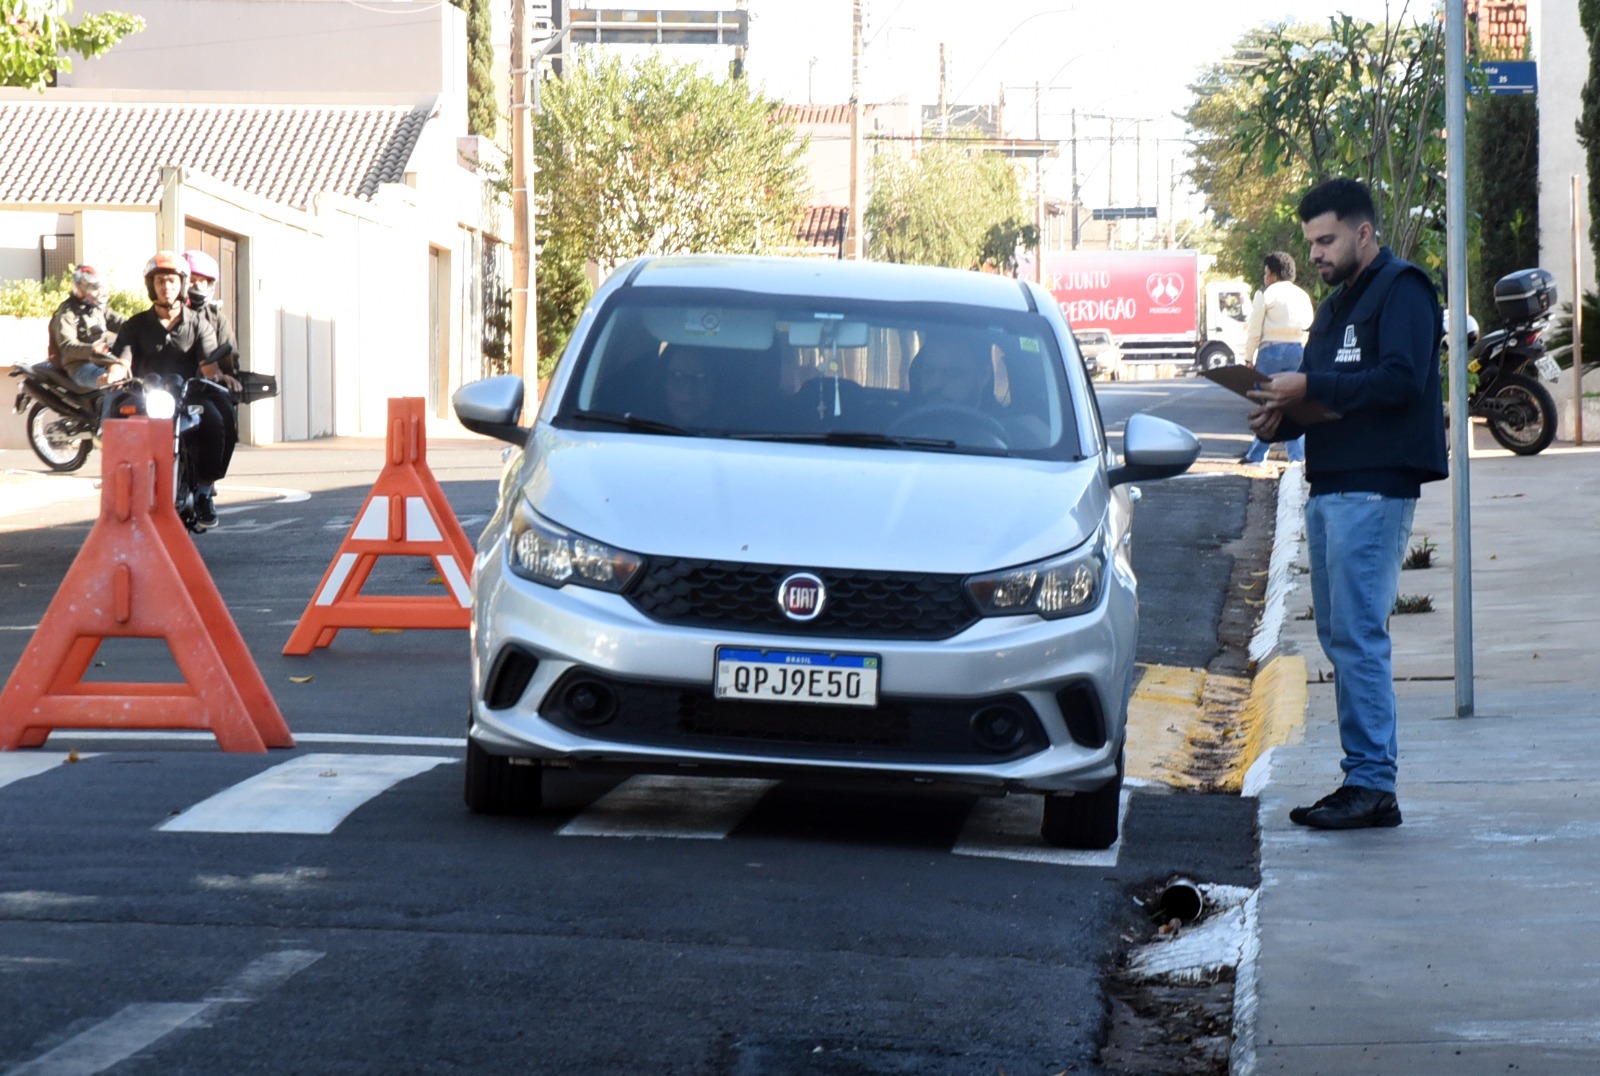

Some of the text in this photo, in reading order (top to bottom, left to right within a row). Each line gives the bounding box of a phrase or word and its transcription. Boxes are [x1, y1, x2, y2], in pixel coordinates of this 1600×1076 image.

[1064, 271, 1110, 291] JUNTO
[1059, 296, 1137, 323] PERDIGÃO
[1334, 353, 1361, 362] AGENTE
[790, 587, 816, 609] FIAT
[786, 656, 812, 664] BRASIL
[734, 667, 861, 698] QPJ9E50
